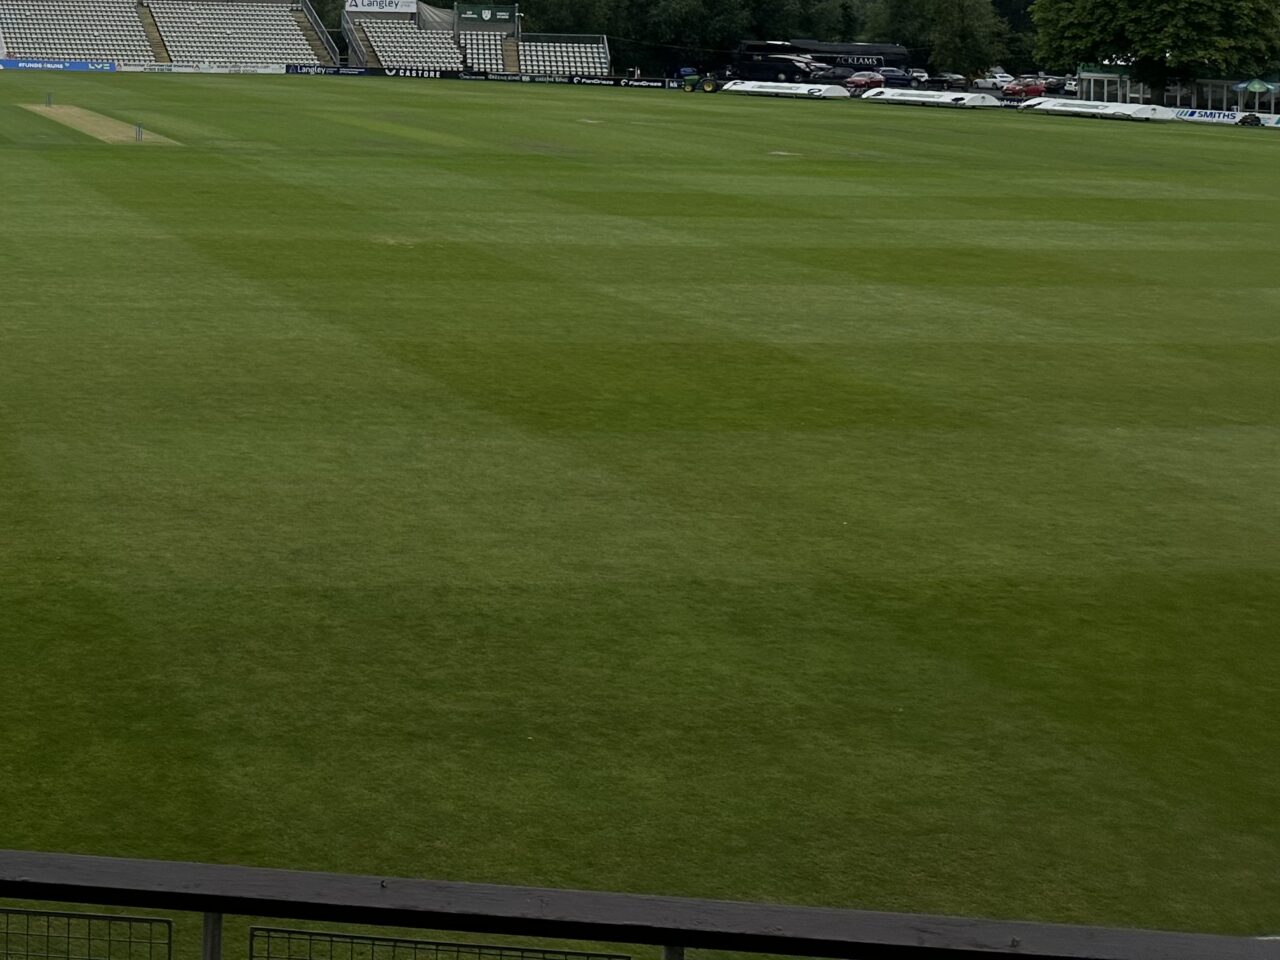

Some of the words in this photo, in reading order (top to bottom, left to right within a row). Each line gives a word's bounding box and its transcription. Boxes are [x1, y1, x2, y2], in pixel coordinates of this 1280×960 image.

[835, 56, 877, 65] ACKLAMS
[297, 66, 326, 75] Langley
[399, 70, 441, 78] CASTORE
[1197, 111, 1236, 120] SMITHS
